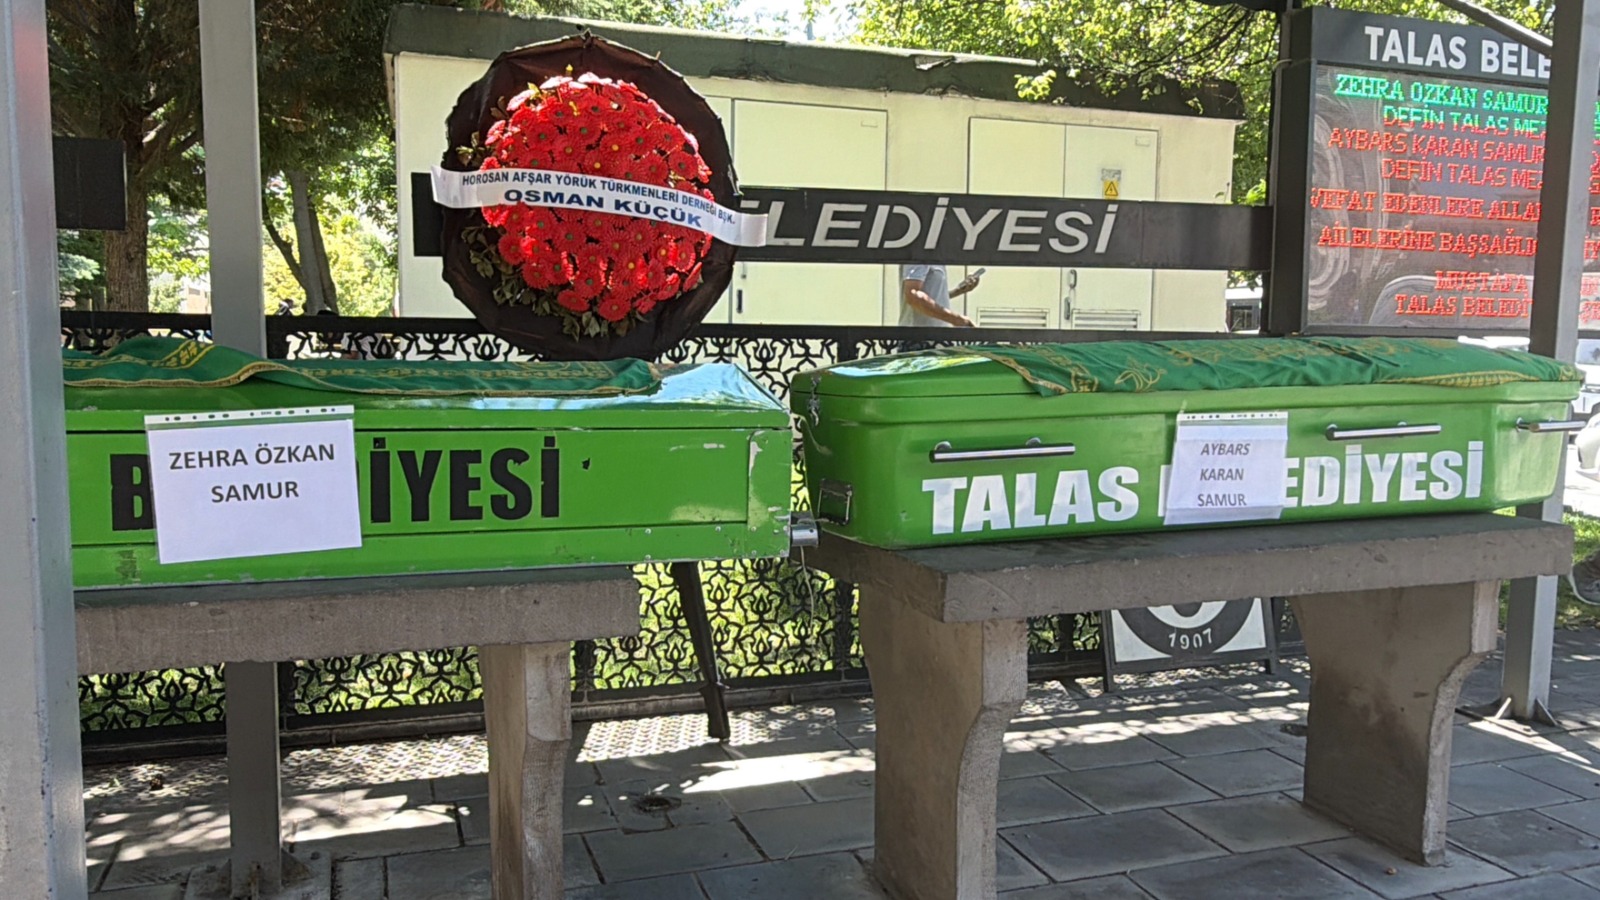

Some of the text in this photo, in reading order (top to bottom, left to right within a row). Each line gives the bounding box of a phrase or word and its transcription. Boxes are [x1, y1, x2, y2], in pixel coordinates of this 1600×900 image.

[1364, 26, 1466, 70] TALAS
[1334, 74, 1404, 101] ZEHRA
[1482, 89, 1549, 115] SAMUR
[1383, 104, 1445, 131] DEFİN
[1450, 112, 1510, 137] TALAS
[1328, 128, 1408, 154] AYBARS
[1412, 134, 1478, 159] KARAN
[1381, 156, 1442, 181] DEFİN
[1448, 163, 1507, 187] TALAS
[462, 171, 509, 186] HOROSAN
[512, 172, 552, 187] AFŞAR
[555, 174, 597, 190] YÖRÜK
[600, 179, 679, 204] TÜRKMENLERİ
[682, 194, 717, 216] DERNEĞİ
[504, 188, 702, 228] OSMAN KÜÇÜK
[1381, 192, 1485, 219] EDENLERE
[740, 197, 1119, 254] LEDİYESİ
[1317, 220, 1437, 251] AİLELERİNE
[1435, 270, 1529, 293] MUSTAFA
[1395, 294, 1458, 316] TALAS
[168, 442, 335, 471] ZEHRA ÖZKAN
[1200, 443, 1251, 456] AYBARS
[1199, 468, 1244, 482] KARAN
[211, 479, 300, 504] SAMUR
[922, 466, 1140, 535] TALAS
[1197, 493, 1248, 507] SAMUR
[1168, 628, 1213, 650] 1907
